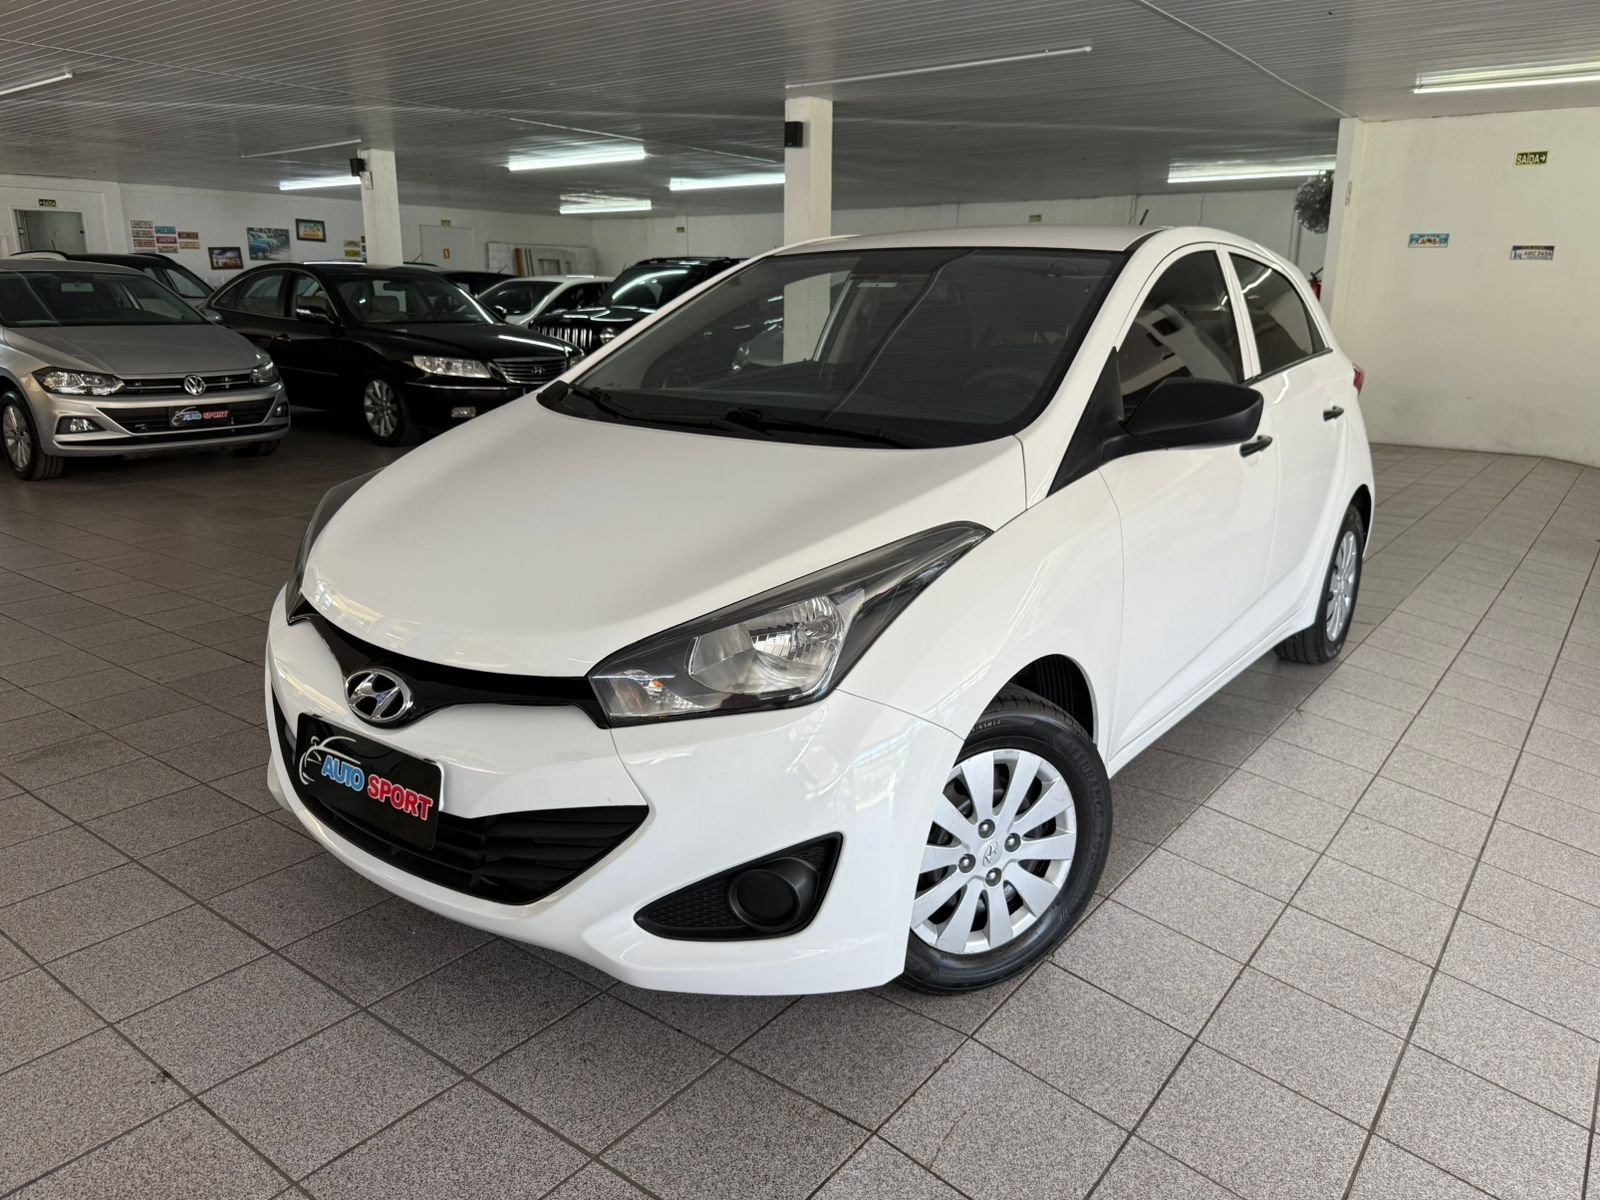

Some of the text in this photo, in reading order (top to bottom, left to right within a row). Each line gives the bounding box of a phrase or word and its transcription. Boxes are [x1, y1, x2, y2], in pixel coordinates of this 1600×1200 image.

[203, 410, 228, 419] SPORT
[321, 754, 433, 821] AUTO SPORT
